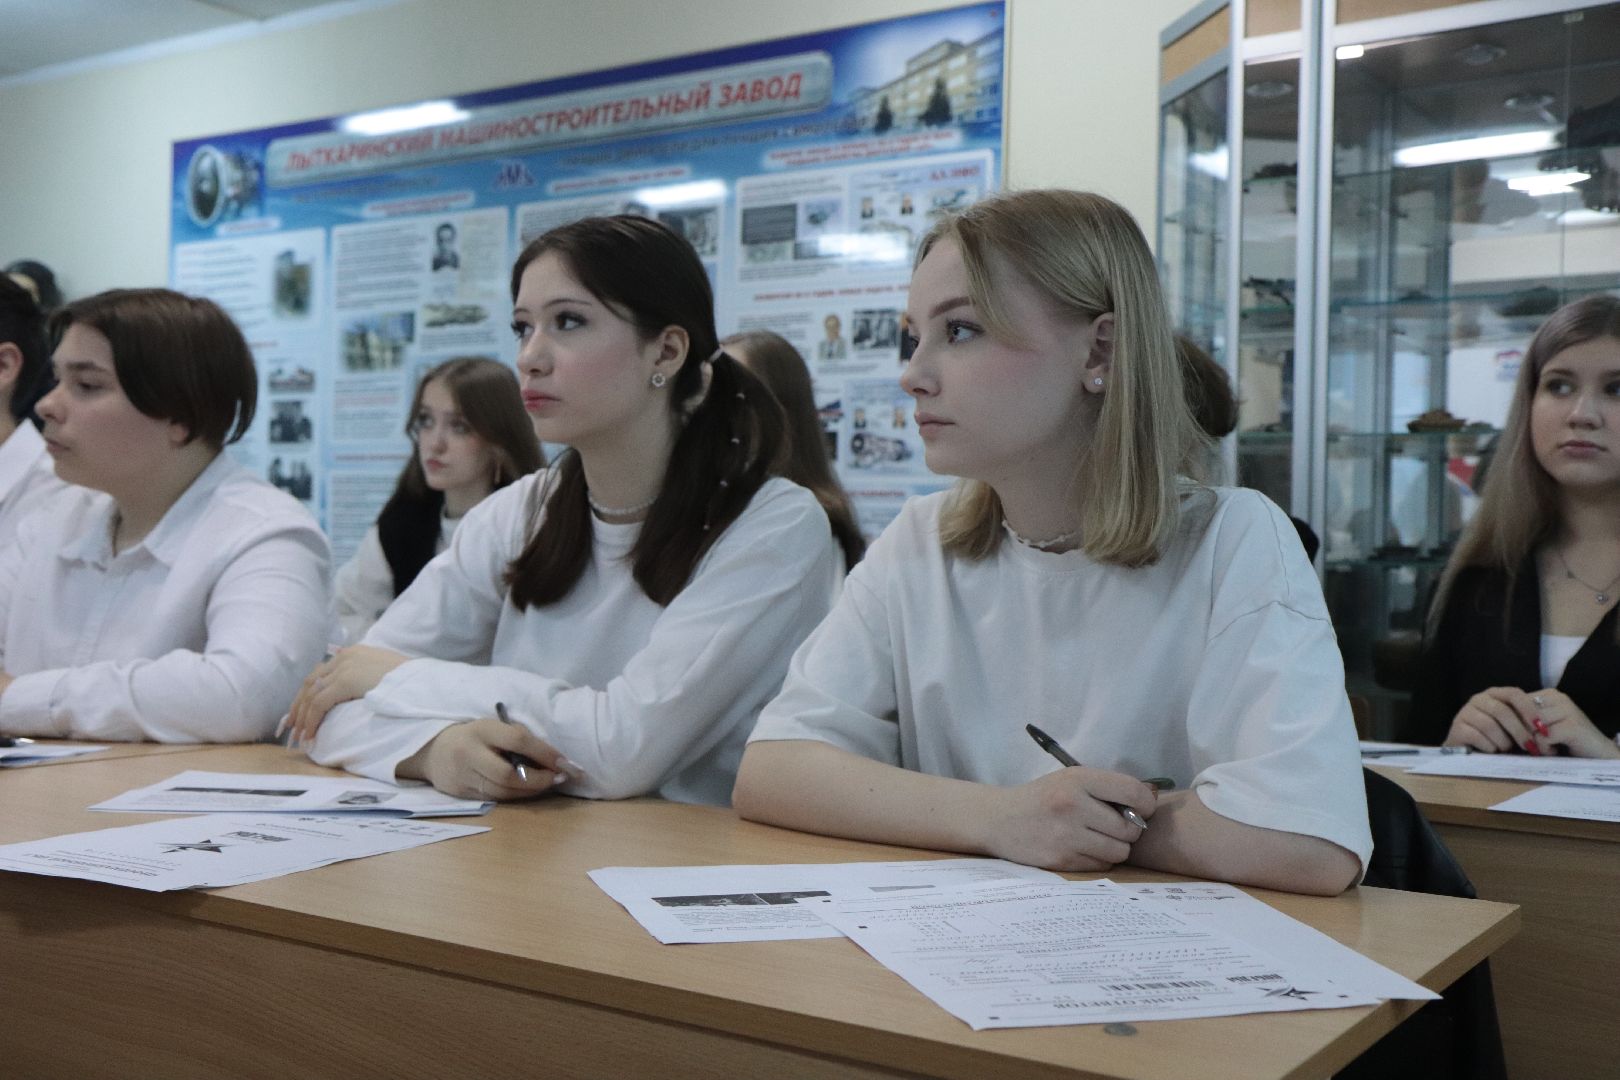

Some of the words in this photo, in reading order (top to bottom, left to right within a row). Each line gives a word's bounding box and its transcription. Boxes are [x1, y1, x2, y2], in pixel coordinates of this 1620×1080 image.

[285, 131, 434, 172] ЛЫТКАРИНСКИЙ
[438, 81, 711, 153] МАШИНОСТРОИТЕЛЬНЫЙ
[717, 72, 806, 110] ЗАВОД
